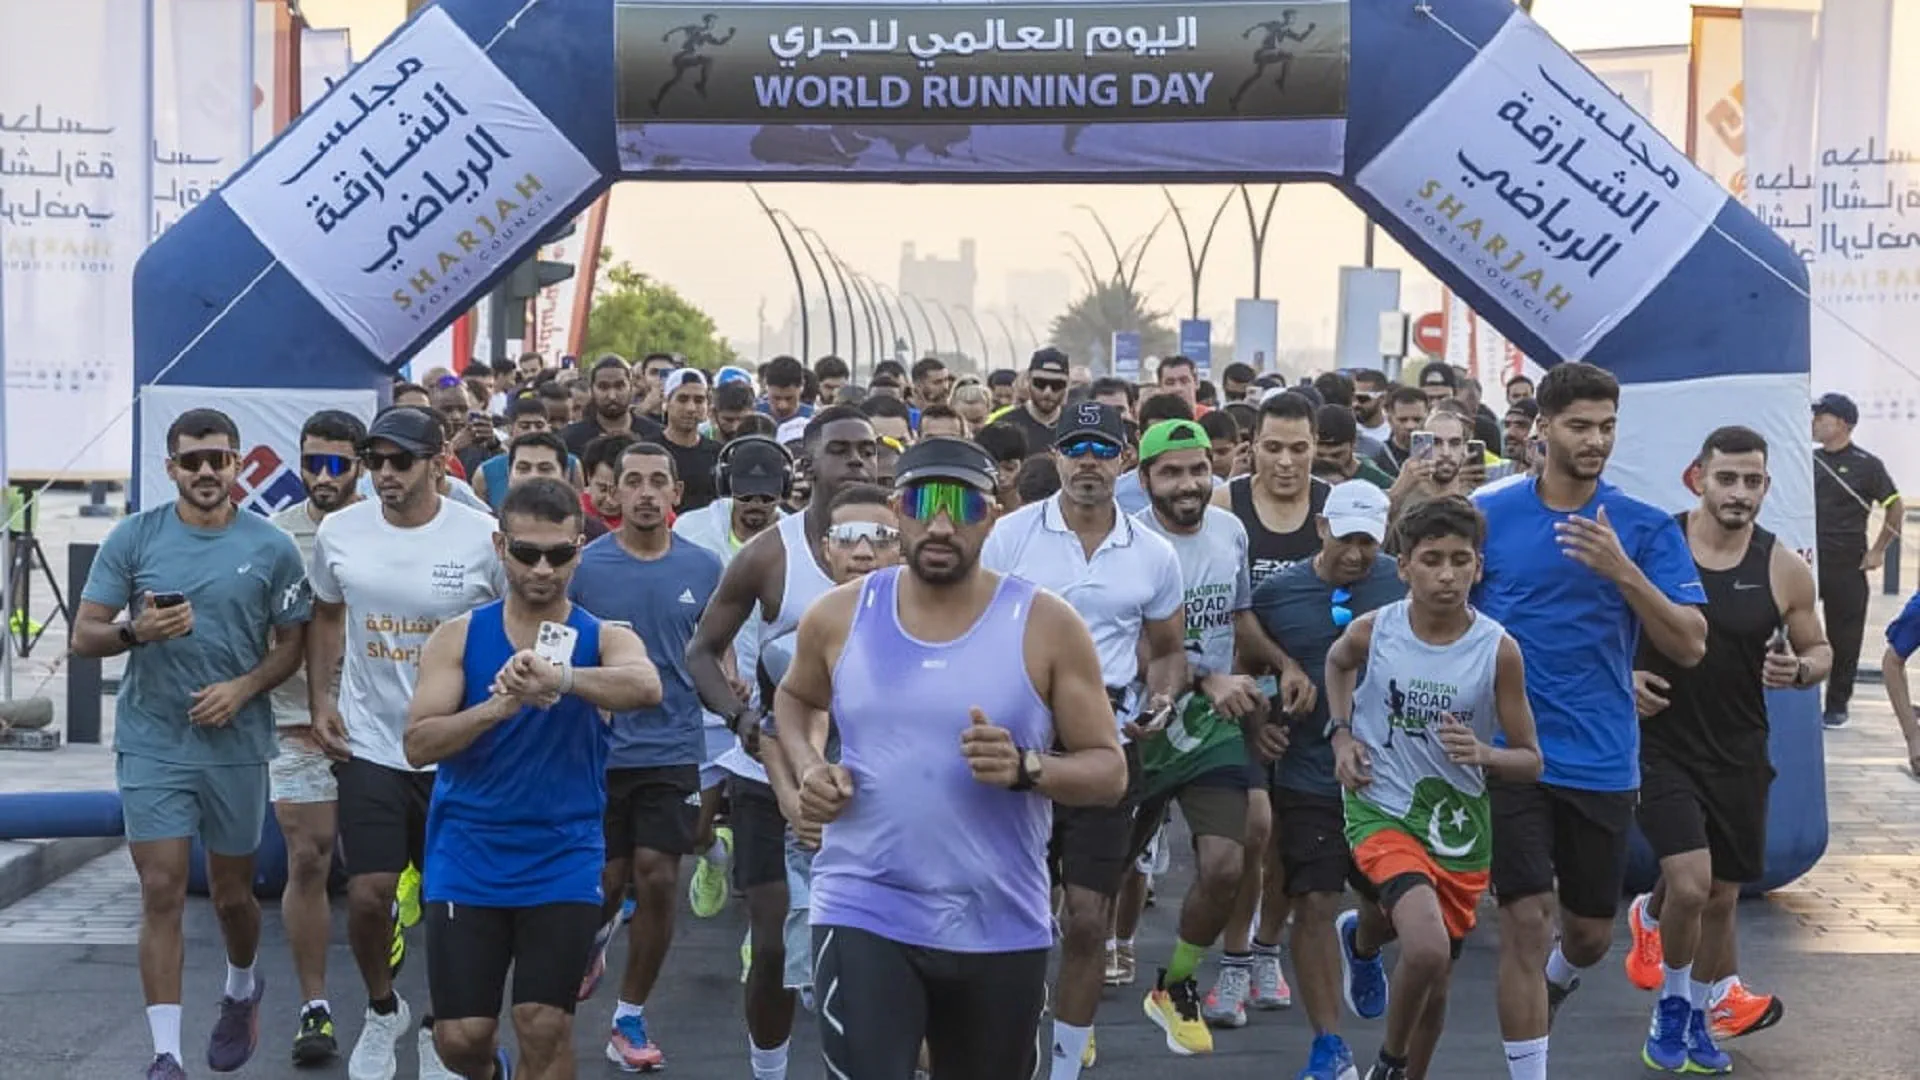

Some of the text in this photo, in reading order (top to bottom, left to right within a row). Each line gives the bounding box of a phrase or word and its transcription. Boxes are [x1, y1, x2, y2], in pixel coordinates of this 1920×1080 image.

[753, 71, 1215, 108] WORLD RUNNING DAY
[768, 16, 1198, 68] اليوم العالمي للجري
[279, 57, 424, 186] مجلس
[306, 81, 469, 235] الشارقة
[1496, 90, 1661, 235] الشارقة
[1537, 63, 1680, 190] مجلس
[361, 123, 512, 273] الرياضي
[391, 172, 544, 311] SHARJAH
[1417, 179, 1574, 312] SHARJAH
[1457, 147, 1623, 279] الرياضي
[1475, 258, 1551, 324] COUNCIL
[1078, 403, 1101, 425] 5
[1408, 691, 1452, 710] ROAD
